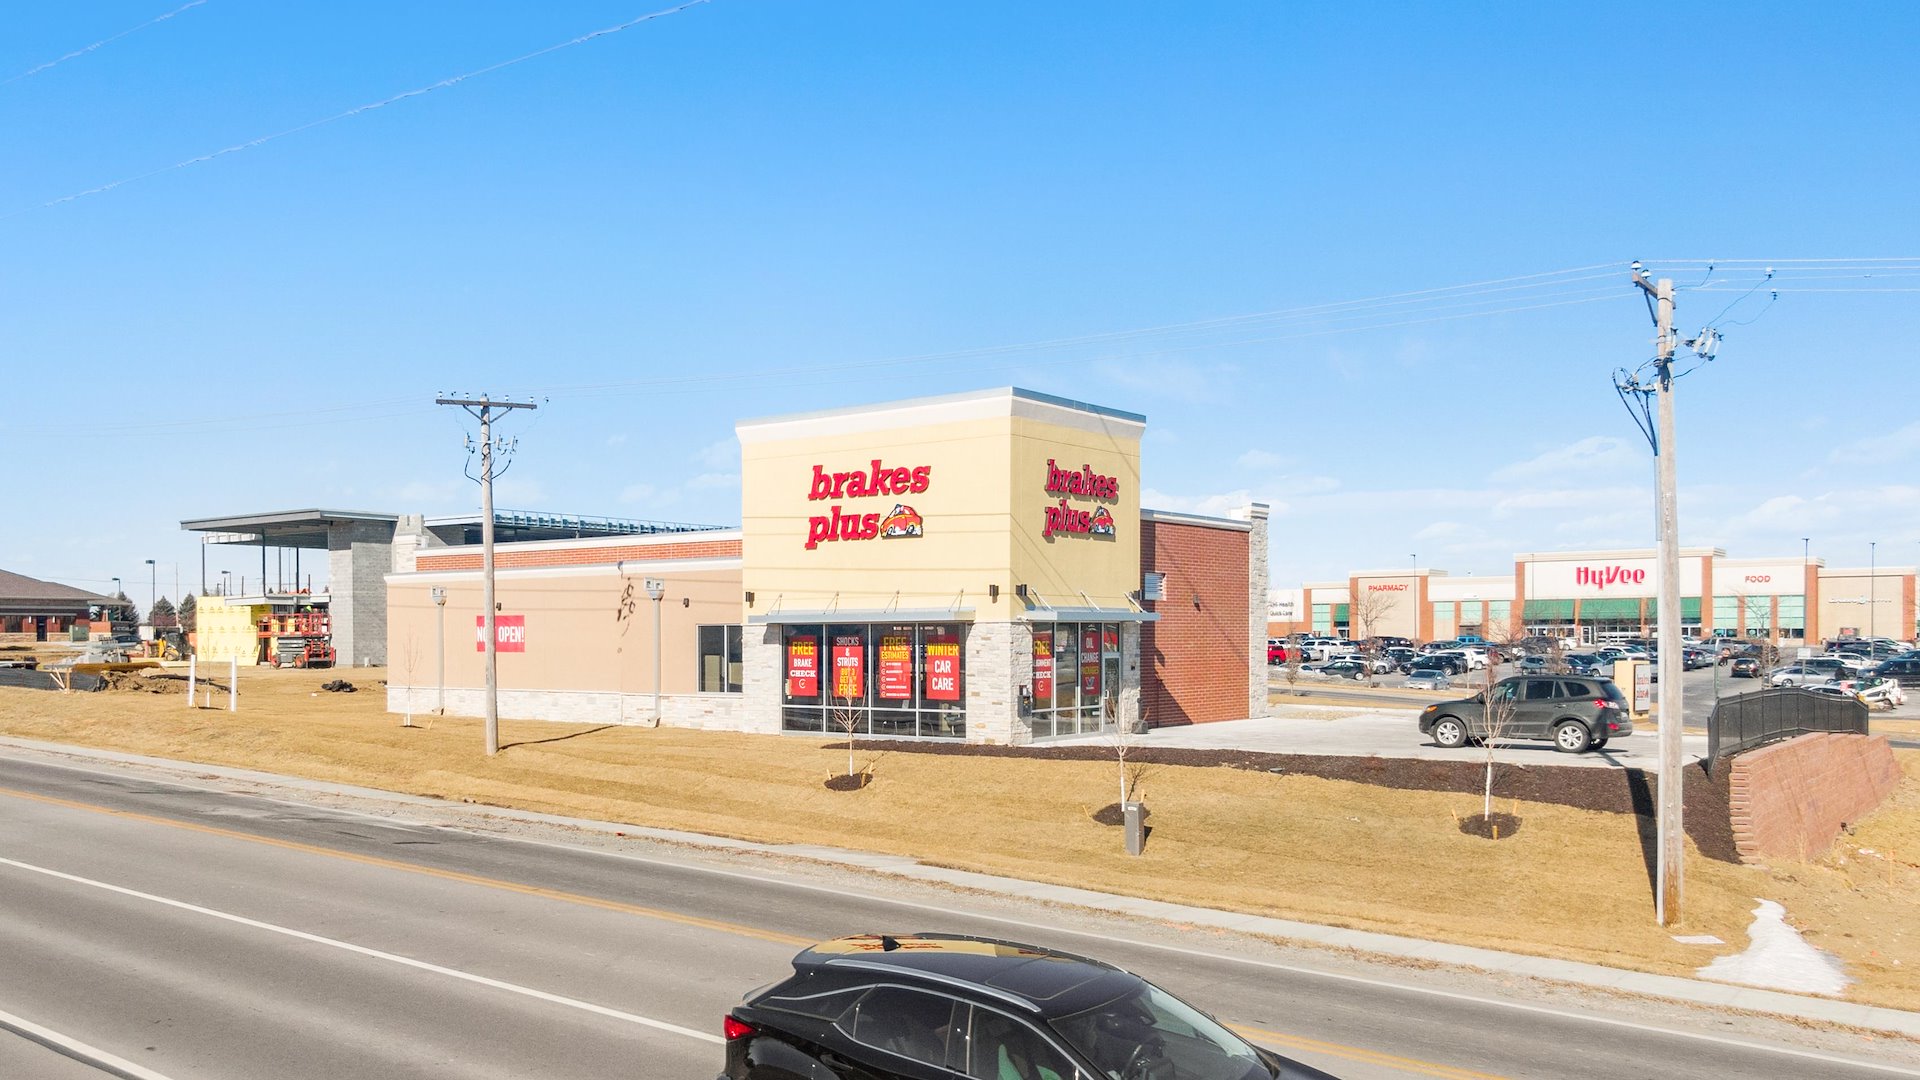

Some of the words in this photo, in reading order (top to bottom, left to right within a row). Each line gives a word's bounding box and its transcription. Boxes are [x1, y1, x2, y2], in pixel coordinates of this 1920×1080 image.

[808, 459, 931, 501] brakes
[1045, 459, 1118, 498] brakes
[1044, 499, 1092, 536] plus
[805, 506, 880, 549] plus
[1744, 575, 1771, 583] FOOD
[1368, 584, 1409, 592] PHARMACY
[498, 626, 525, 643] OPEN!
[792, 641, 814, 655] FREE
[836, 637, 859, 646] SHOCKS
[883, 637, 907, 651] FREE
[1033, 641, 1050, 655] FREE
[1086, 638, 1094, 648] OIL
[845, 648, 850, 657] &
[881, 651, 909, 660] ESTIMATES
[927, 644, 959, 656] WINTER
[793, 658, 812, 668] BRAKE
[837, 657, 859, 667] STRUTS
[934, 660, 951, 674] CAR
[790, 669, 816, 678] CHECK
[931, 677, 954, 691] CARE
